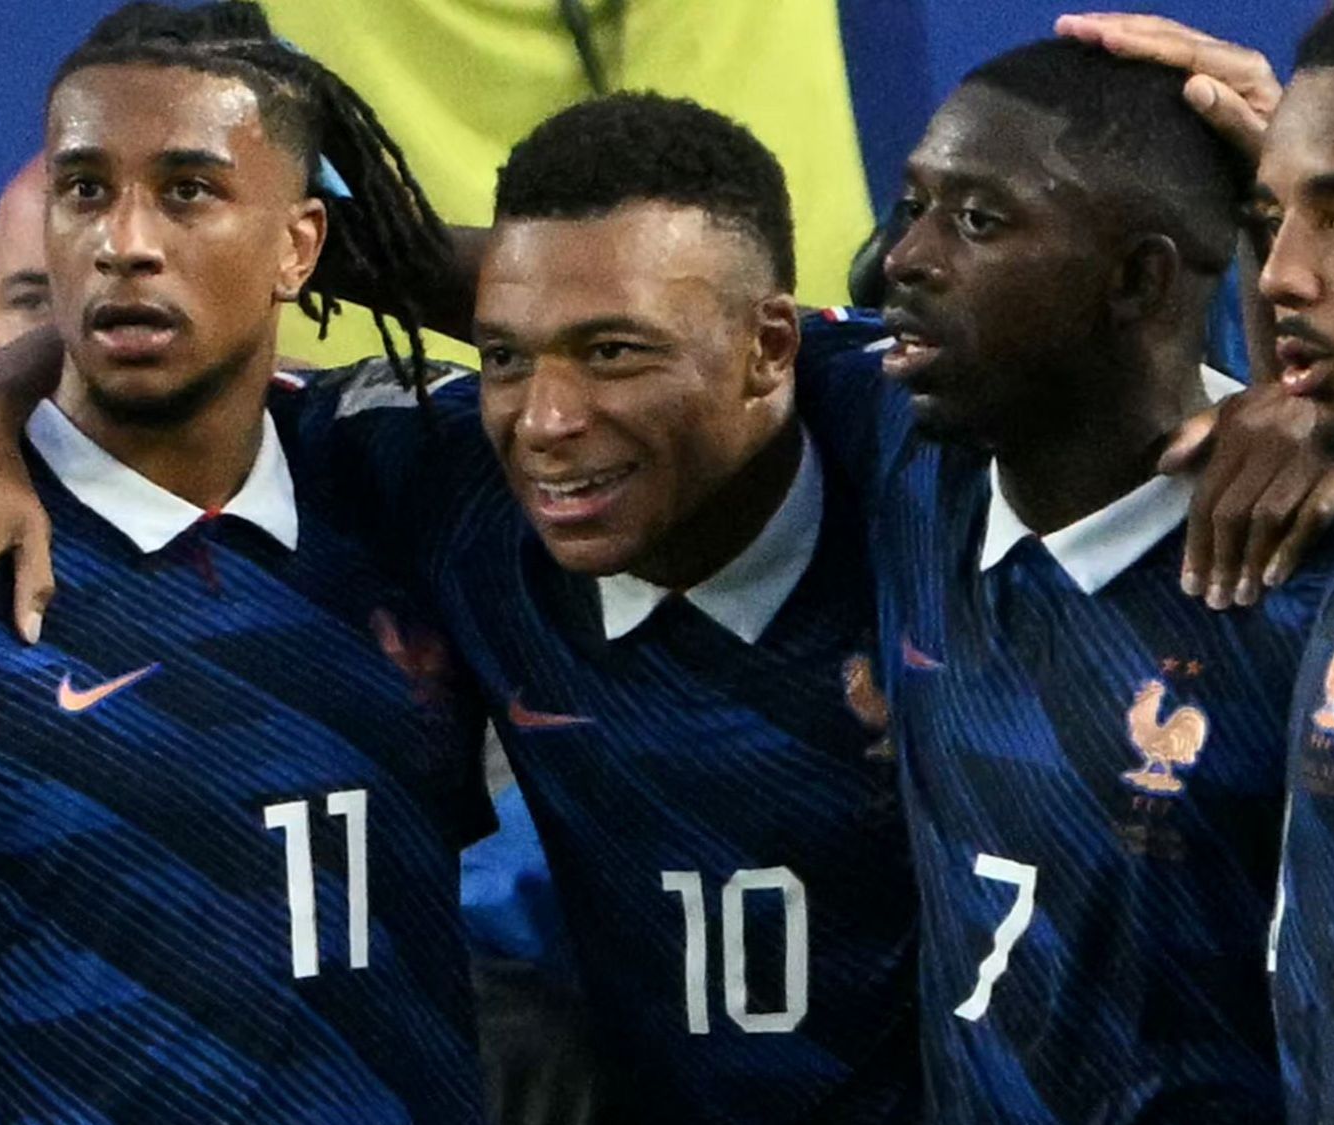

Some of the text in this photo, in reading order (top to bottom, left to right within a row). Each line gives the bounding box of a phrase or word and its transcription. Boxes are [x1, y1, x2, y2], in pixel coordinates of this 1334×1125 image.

[263, 789, 369, 979] 11
[661, 866, 808, 1034] 10
[953, 852, 1038, 1022] 7
